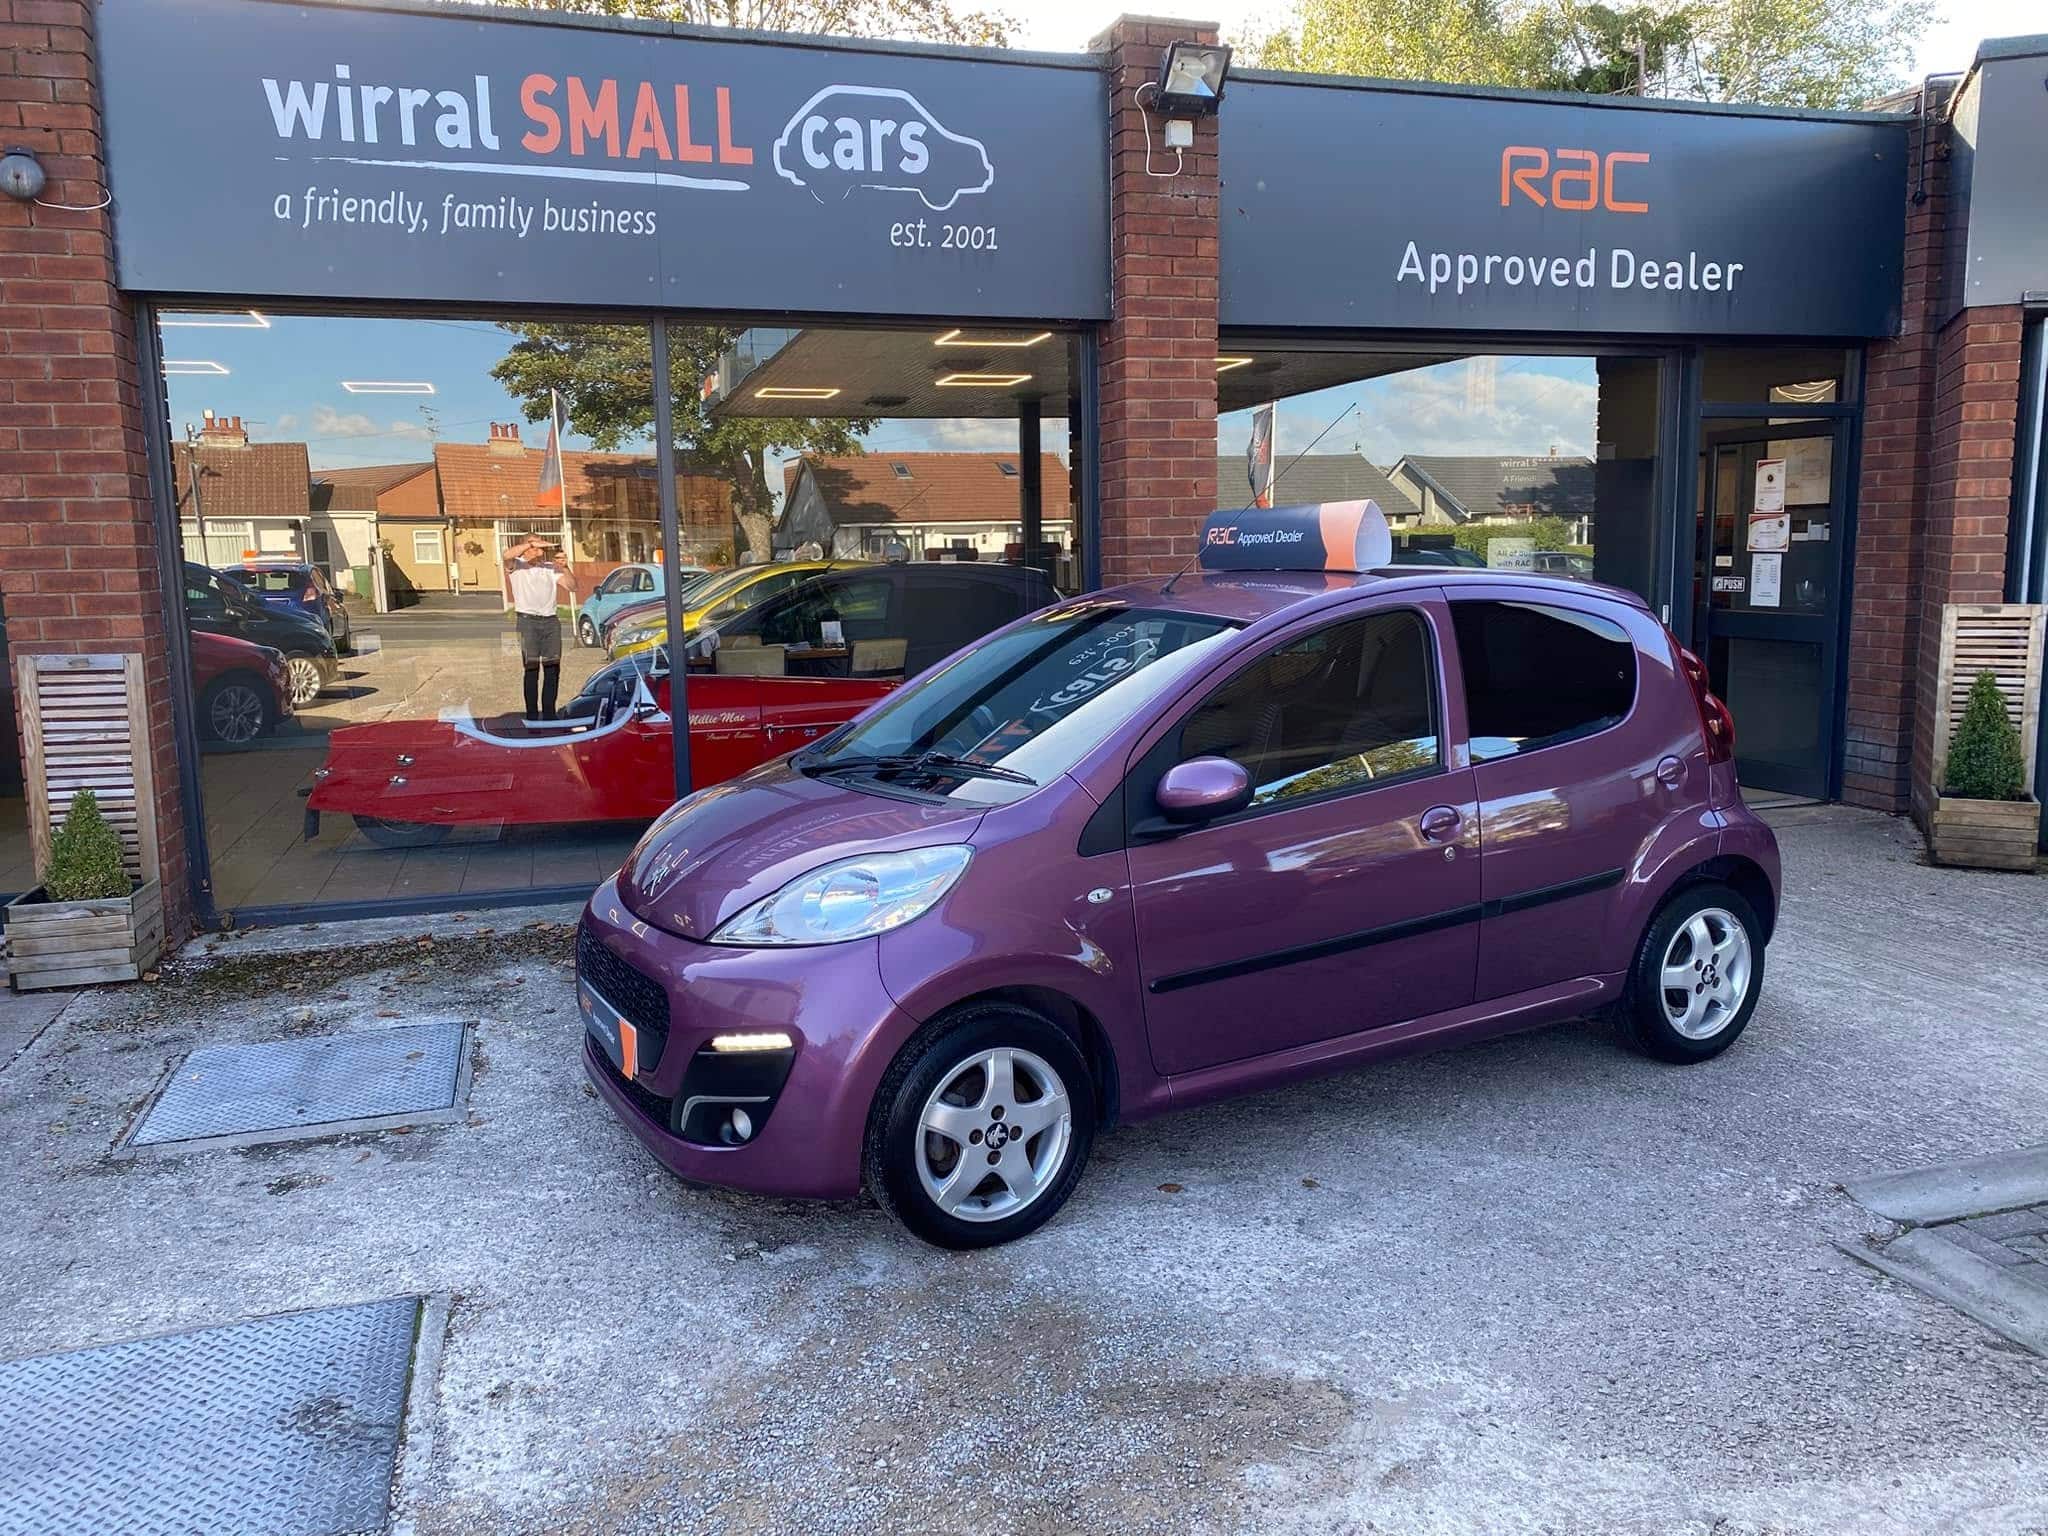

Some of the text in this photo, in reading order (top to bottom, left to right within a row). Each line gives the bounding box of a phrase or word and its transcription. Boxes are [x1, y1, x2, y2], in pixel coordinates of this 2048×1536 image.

[262, 64, 930, 174] wirral SMALL cars
[273, 187, 657, 238] a friendly, family business
[890, 221, 998, 251] est. 2001
[1396, 240, 1744, 295] Approved Dealer
[1238, 531, 1275, 547] Approved
[1275, 530, 1304, 543] Dealer
[1723, 578, 1743, 589] PUSH
